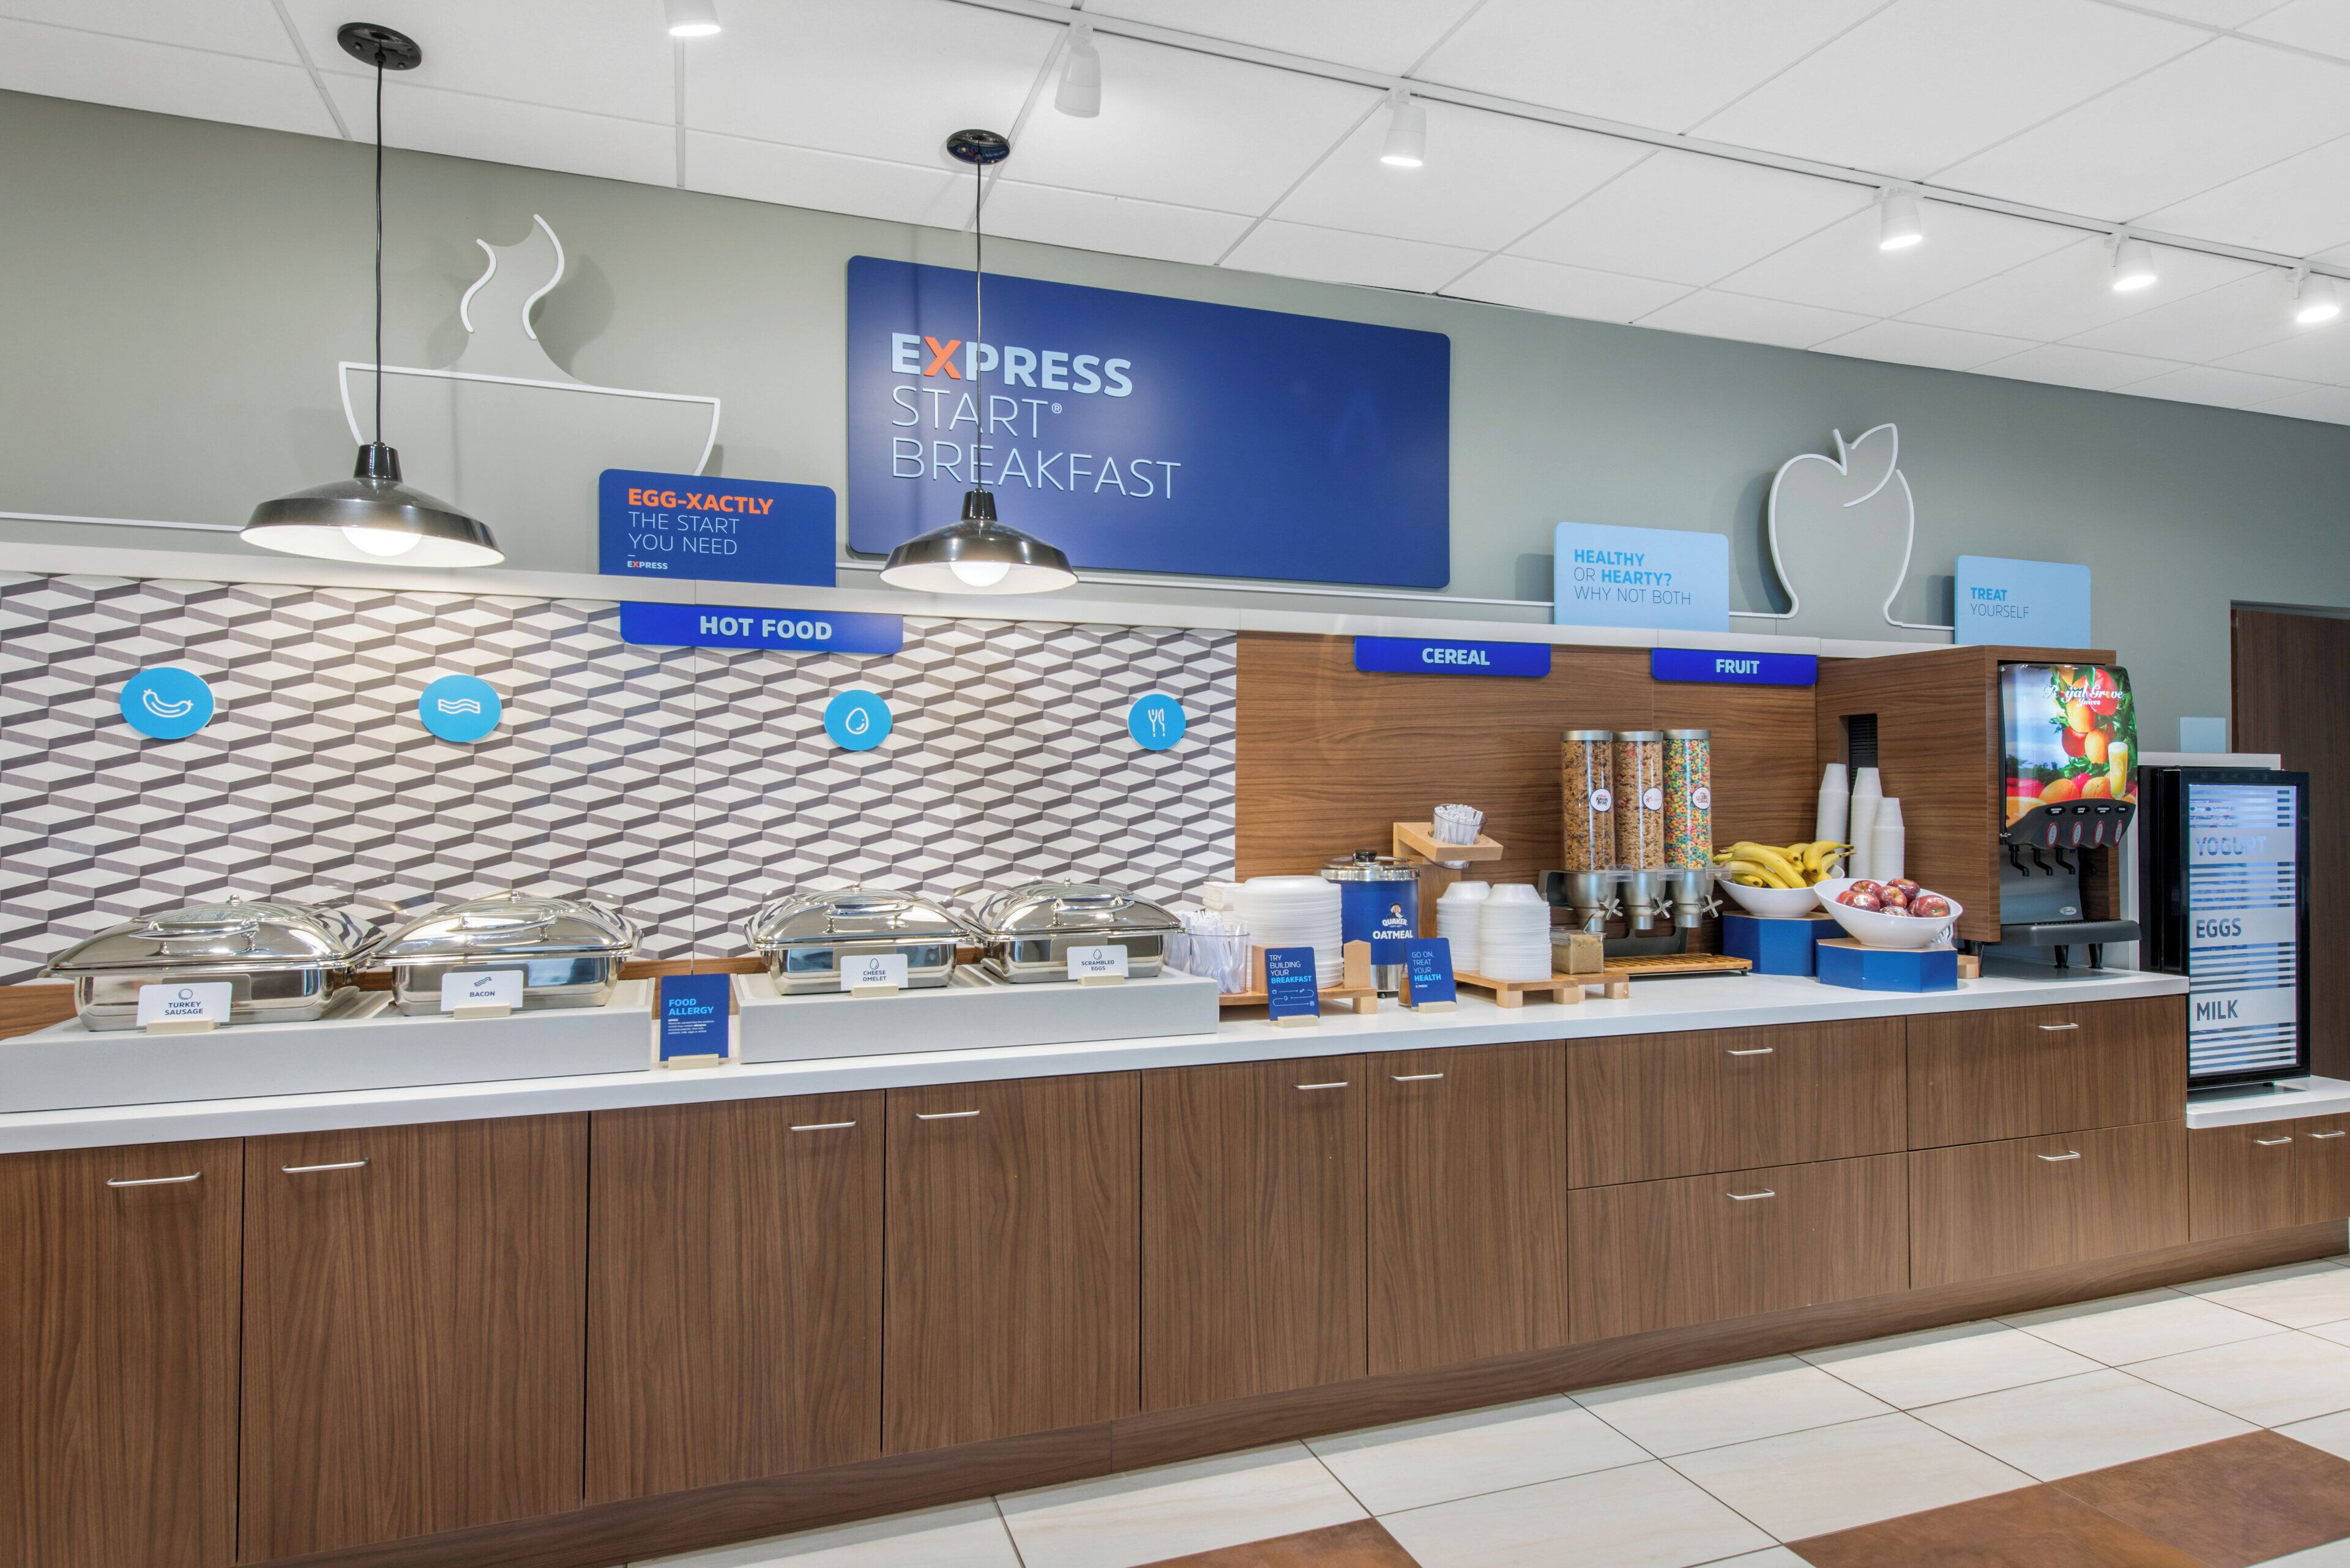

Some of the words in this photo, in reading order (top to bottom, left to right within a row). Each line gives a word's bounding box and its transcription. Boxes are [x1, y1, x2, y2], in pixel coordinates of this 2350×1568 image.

[891, 332, 1133, 397] EXPRESS
[892, 436, 1181, 499] BREAKFAST
[628, 488, 774, 515] EGG-XACTLY
[628, 511, 669, 530] THE
[677, 515, 740, 534] START
[628, 532, 674, 551] YOU
[683, 536, 737, 555] NEED
[627, 560, 668, 570] EXPRESS
[1573, 548, 1645, 567] HEALTHY
[1573, 567, 1595, 582] OR
[1601, 569, 1672, 587] HEARTY?
[1573, 585, 1611, 602] WHY
[1617, 587, 1647, 603] NOT
[1652, 589, 1691, 605] BOTH
[1970, 586, 2007, 602] TREAT
[1970, 603, 2029, 619] YOURSELF
[699, 616, 754, 637] HOT
[762, 619, 832, 640] FOOD
[1421, 647, 1491, 666] CEREAL
[1715, 658, 1760, 675] FRUIT
[2076, 698, 2102, 707] Juices
[2196, 835, 2267, 856] YOGURT
[1382, 918, 1408, 927] QUAKER
[2196, 917, 2242, 939] EGGS
[1372, 930, 1414, 939] OATMEAL
[1270, 961, 1301, 969] BUILDING
[1270, 975, 1313, 984] BREAKFAST
[668, 998, 697, 1007] FOOD
[668, 1006, 715, 1016] ALLERGY
[2196, 999, 2239, 1021] MILK
